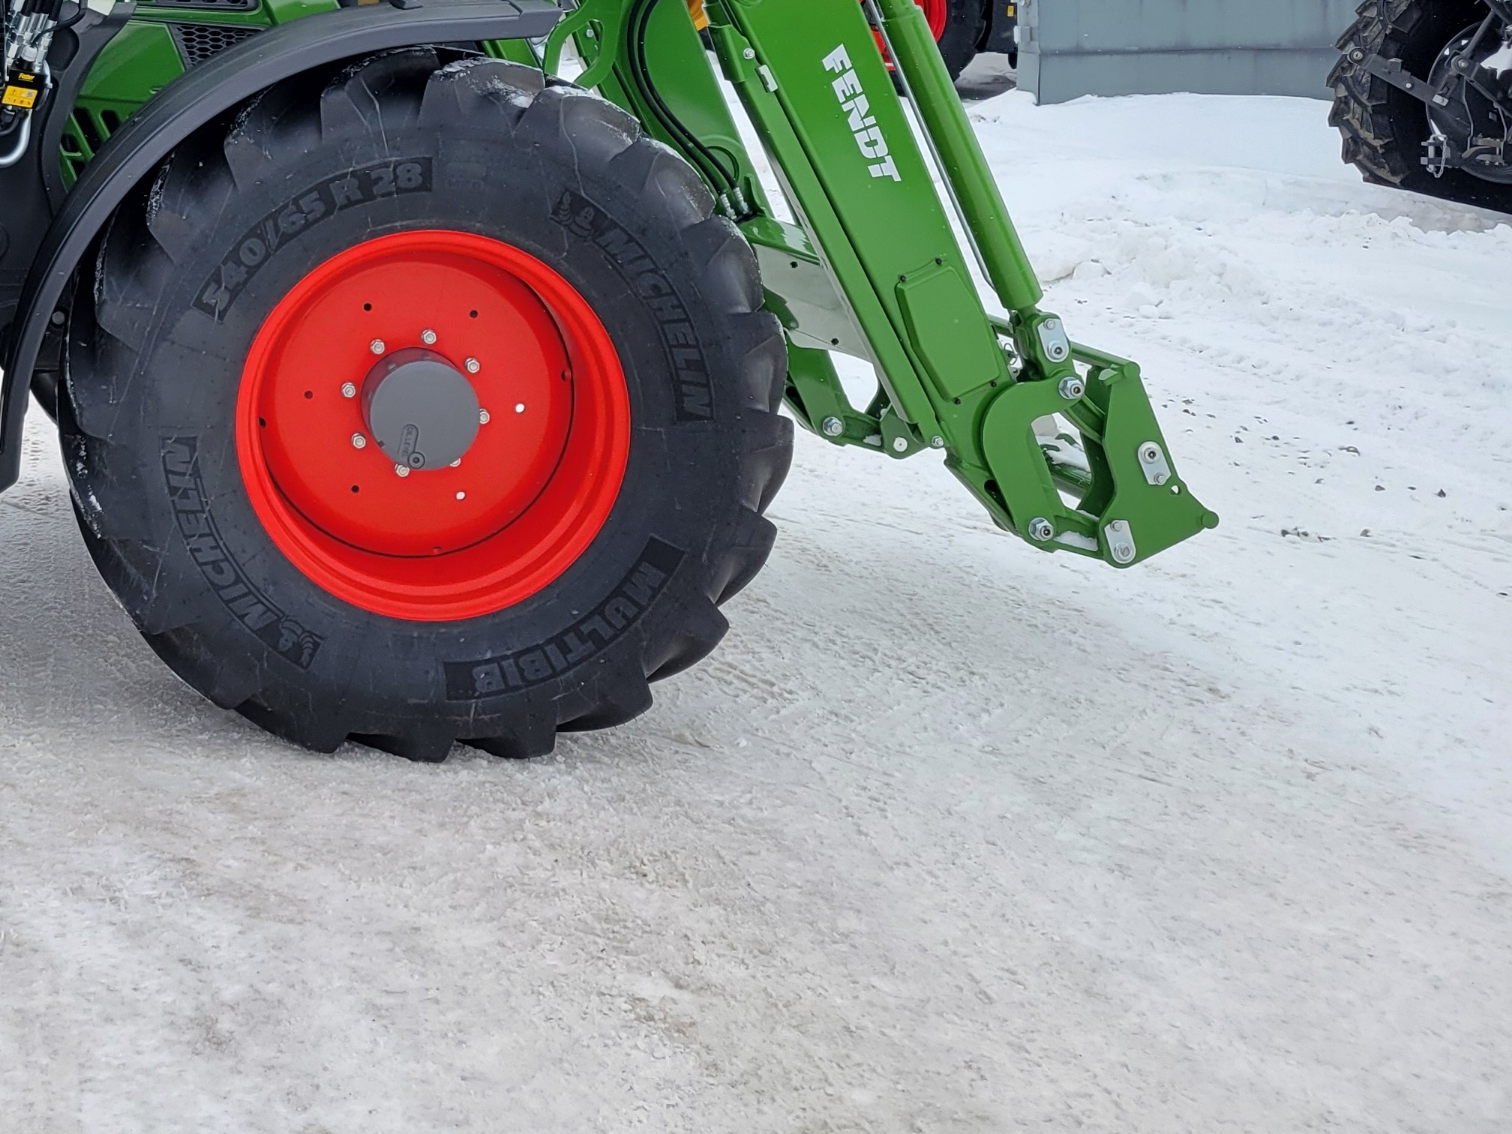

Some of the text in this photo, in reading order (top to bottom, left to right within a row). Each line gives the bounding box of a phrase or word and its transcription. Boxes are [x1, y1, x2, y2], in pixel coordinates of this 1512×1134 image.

[821, 43, 902, 182] FENDT
[201, 162, 423, 312] 540/65 R 28
[596, 222, 713, 418] MICHELIN
[162, 441, 281, 632] MICHELIN
[471, 561, 667, 694] MULTIBIB
